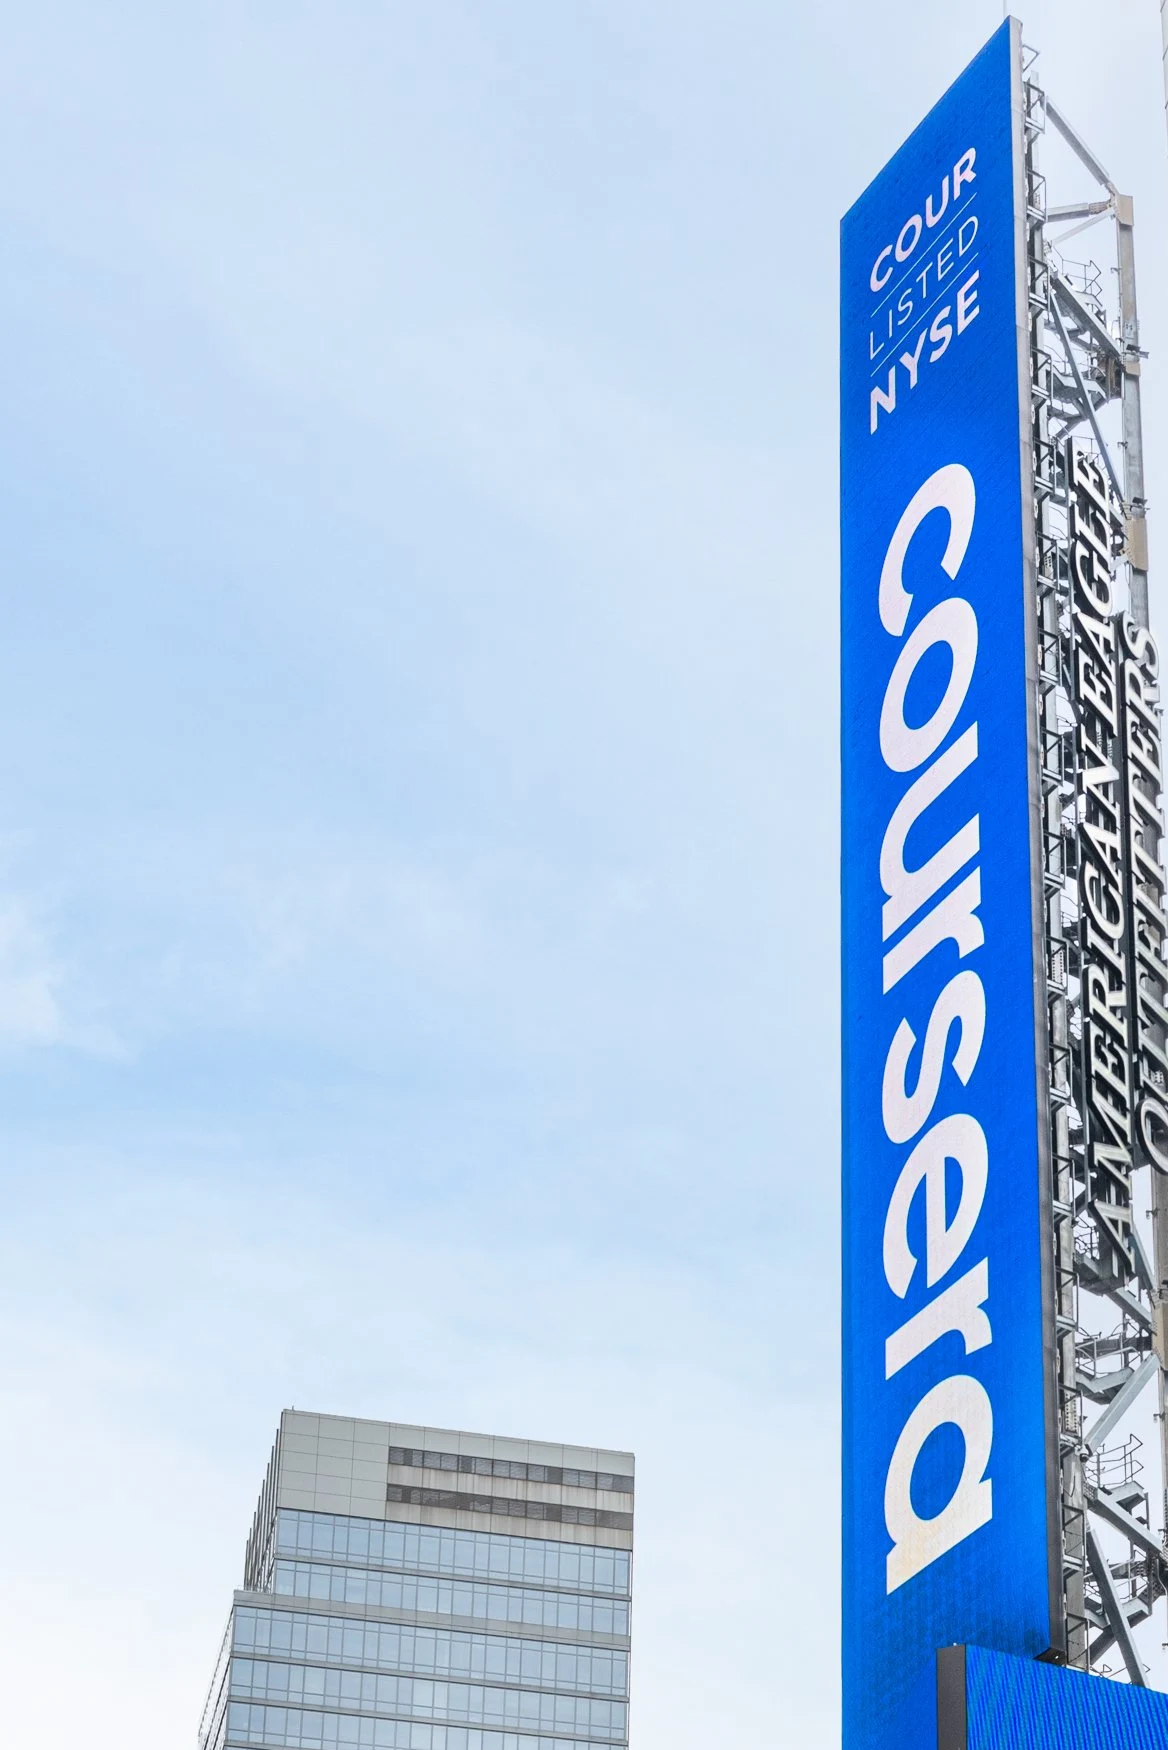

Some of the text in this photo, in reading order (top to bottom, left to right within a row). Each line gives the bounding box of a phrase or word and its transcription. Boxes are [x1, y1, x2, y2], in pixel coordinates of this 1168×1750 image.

[869, 215, 980, 362] LISTED
[871, 146, 977, 292] COUR
[869, 269, 981, 435] NYSE
[1067, 448, 1135, 1279] AMERICAN EAGLE
[878, 463, 993, 1595] coursera
